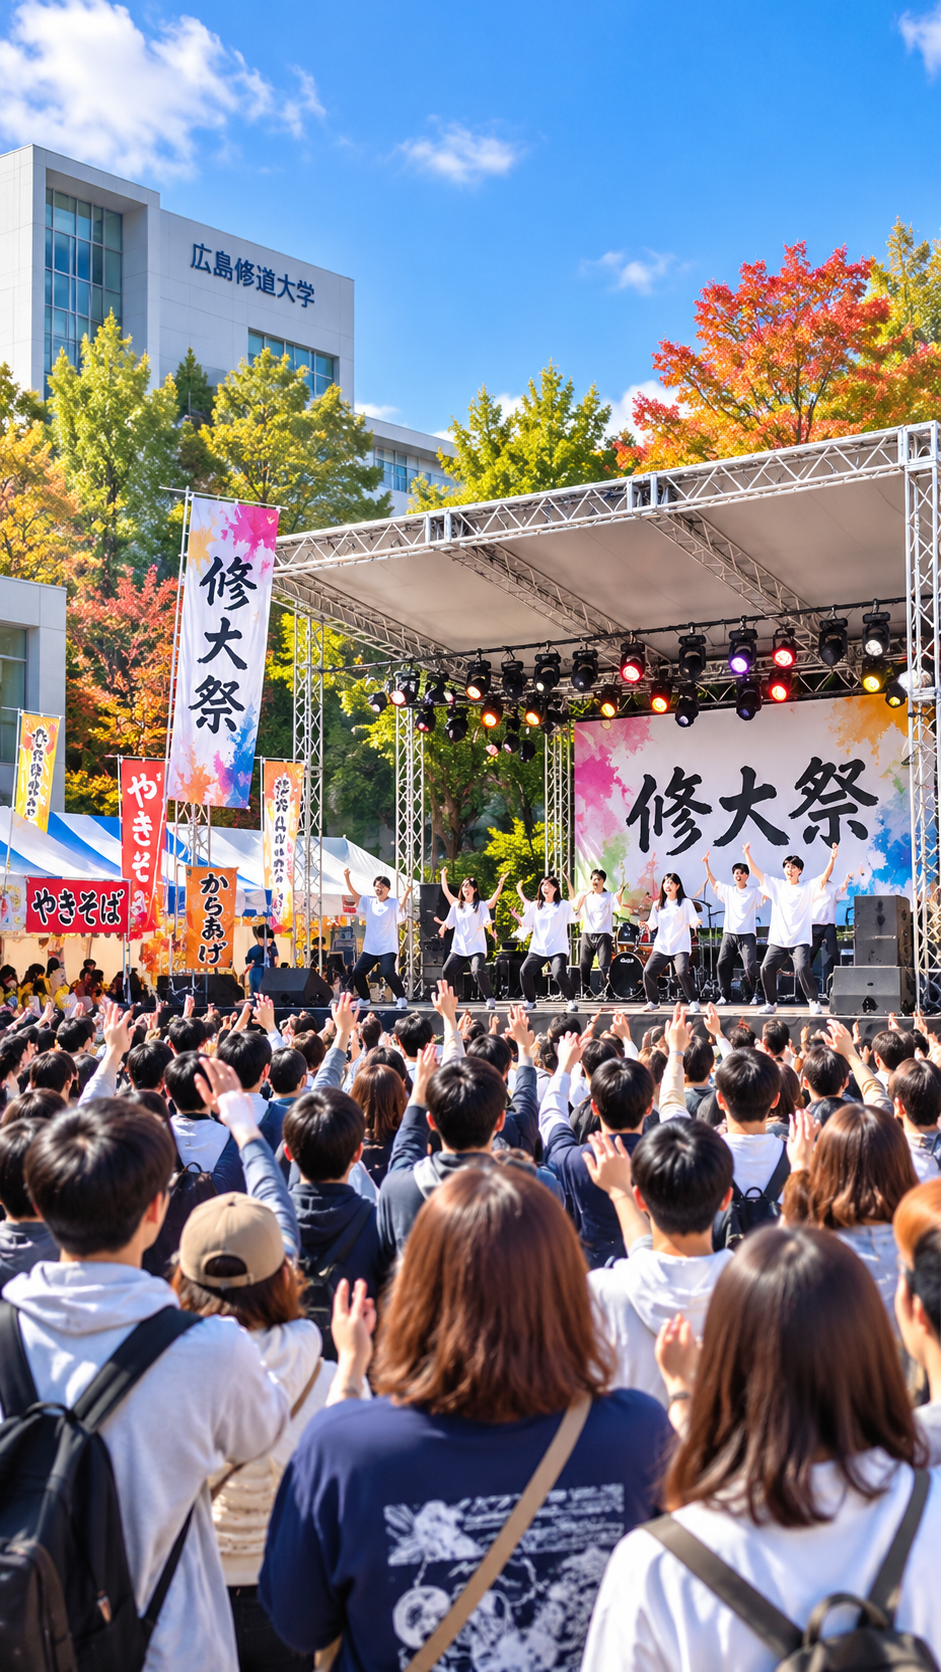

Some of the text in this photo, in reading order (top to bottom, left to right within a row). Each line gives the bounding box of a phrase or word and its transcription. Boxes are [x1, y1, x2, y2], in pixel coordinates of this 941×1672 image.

[191, 243, 315, 308] 広島修道大学
[188, 556, 257, 734] 修大祭
[626, 756, 879, 856] 修大祭
[32, 887, 125, 926] やきそば
[198, 872, 229, 965] からあげ
